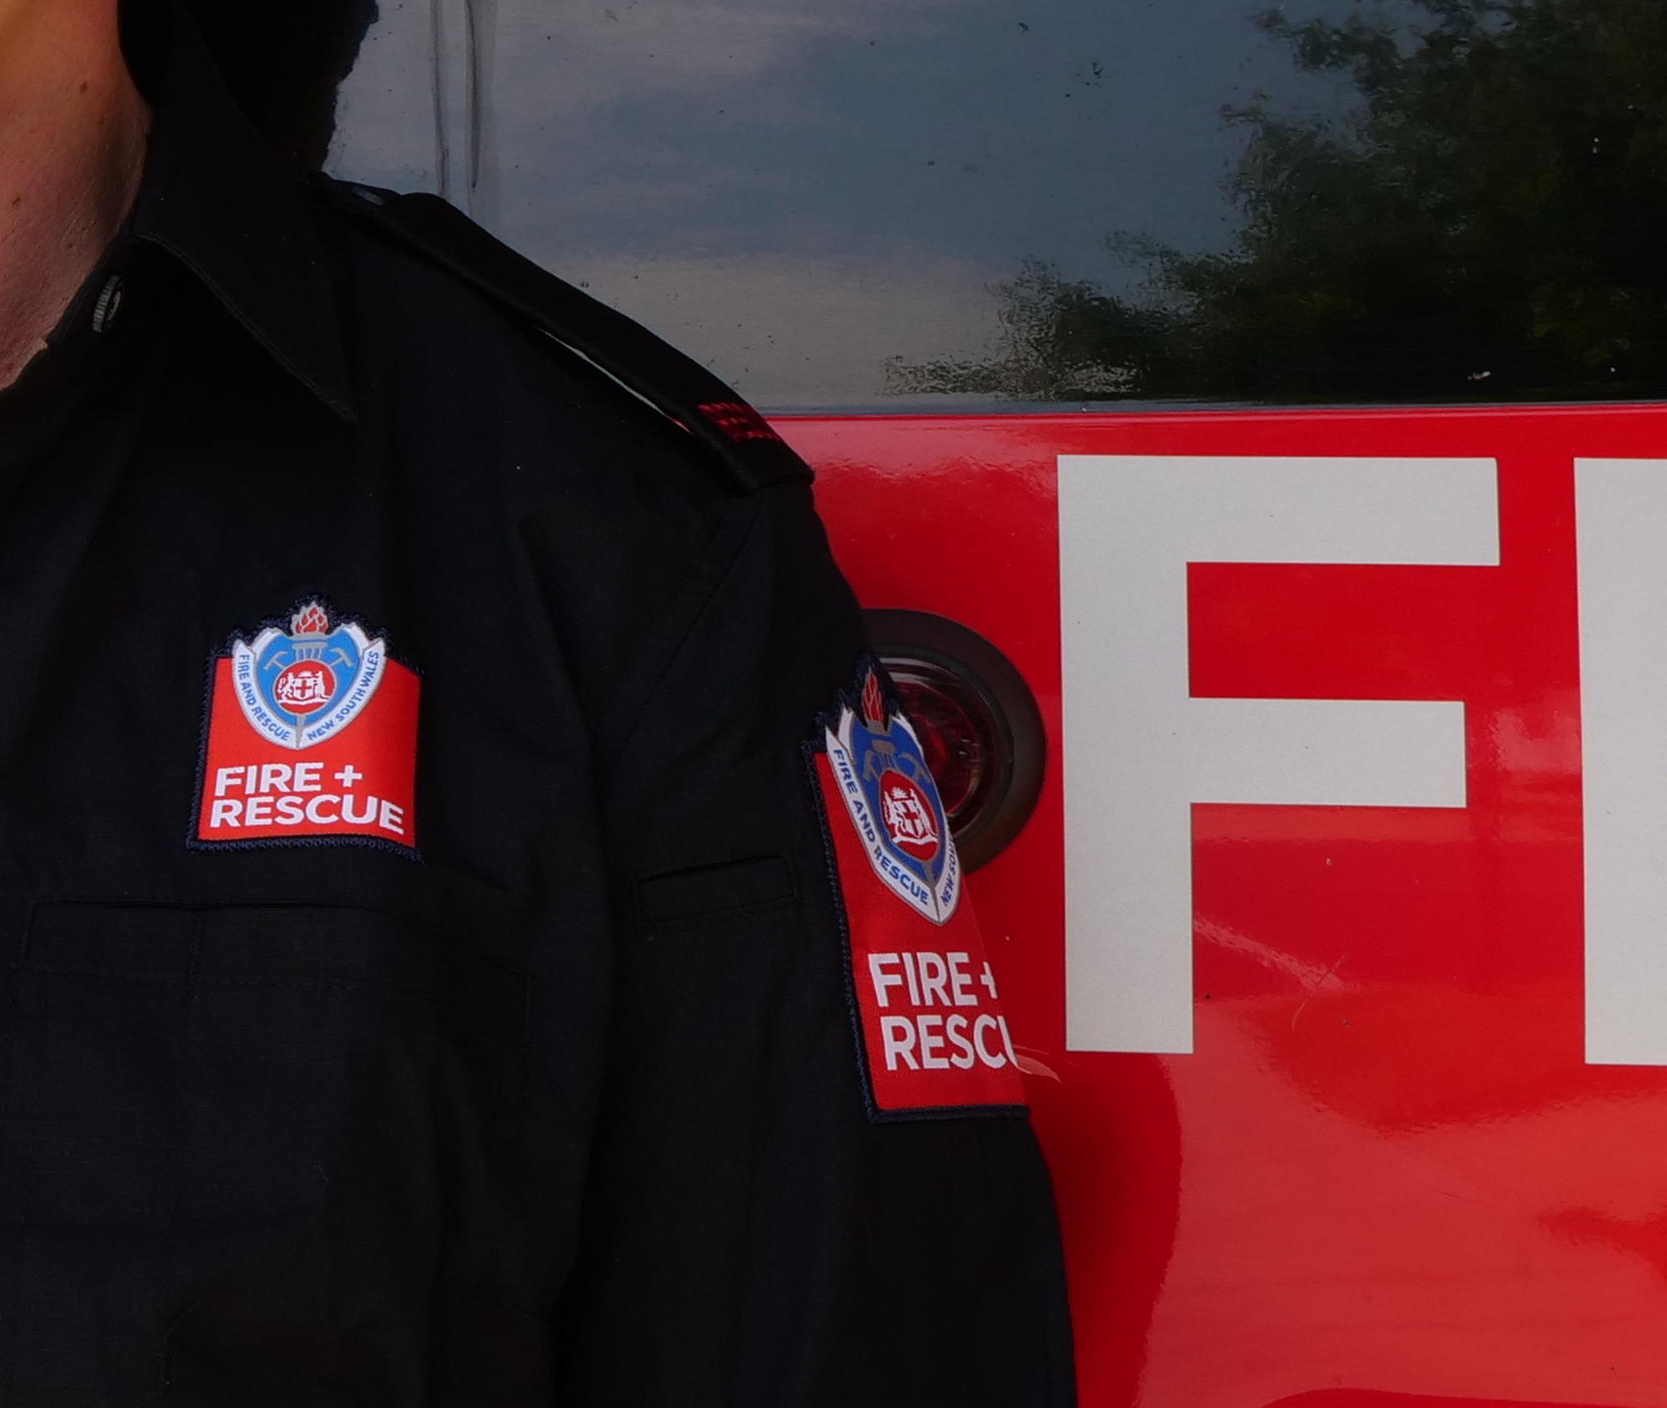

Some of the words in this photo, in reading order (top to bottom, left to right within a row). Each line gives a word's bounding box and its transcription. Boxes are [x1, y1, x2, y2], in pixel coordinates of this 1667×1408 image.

[238, 654, 250, 678] FIRE
[241, 682, 256, 705] AND
[307, 722, 335, 741] NEW
[336, 691, 366, 722] SOUTH
[361, 651, 380, 691] WALES
[251, 703, 291, 741] RESCUE
[214, 762, 324, 797] FIRE
[210, 794, 404, 835] RESCUE
[833, 748, 858, 794] FIRE
[853, 799, 876, 843] AND
[873, 845, 928, 905] RESCUE
[868, 951, 978, 1008] FIRE
